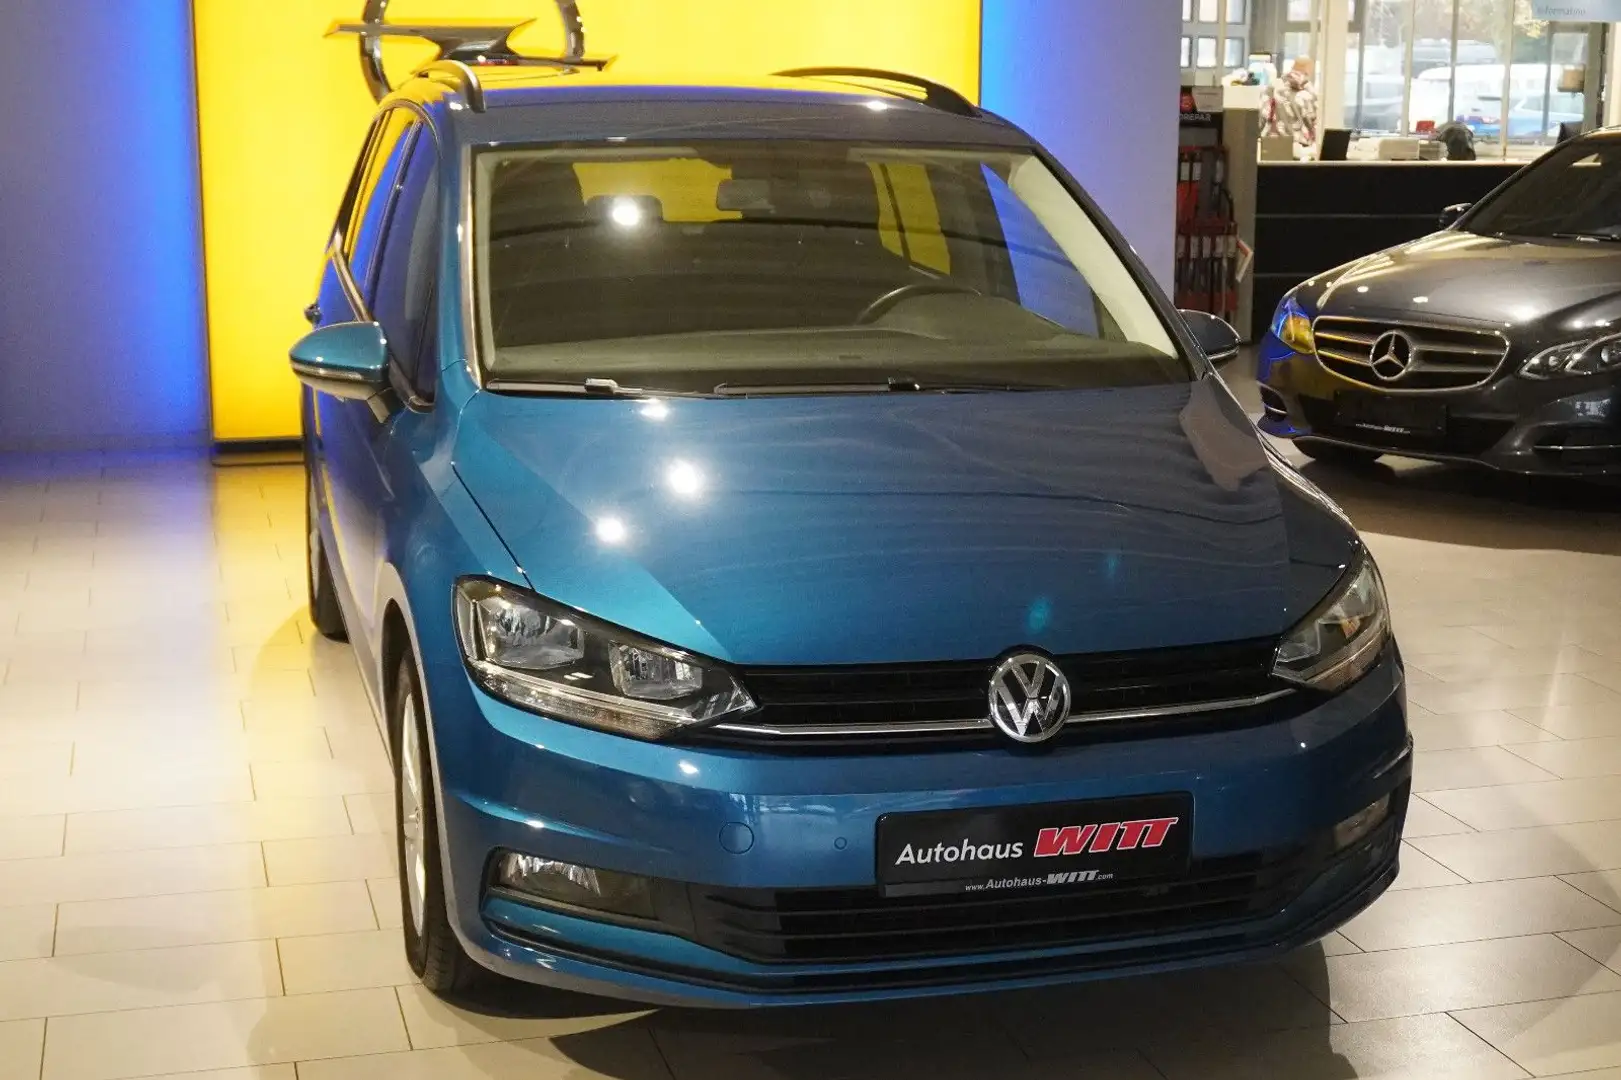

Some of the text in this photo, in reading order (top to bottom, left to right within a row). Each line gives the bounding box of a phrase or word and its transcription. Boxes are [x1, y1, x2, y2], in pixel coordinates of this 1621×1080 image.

[989, 654, 1071, 742] VW
[895, 817, 1179, 865] Autohaus WITT
[965, 869, 1114, 891] www.Autohaus-WITT.com
